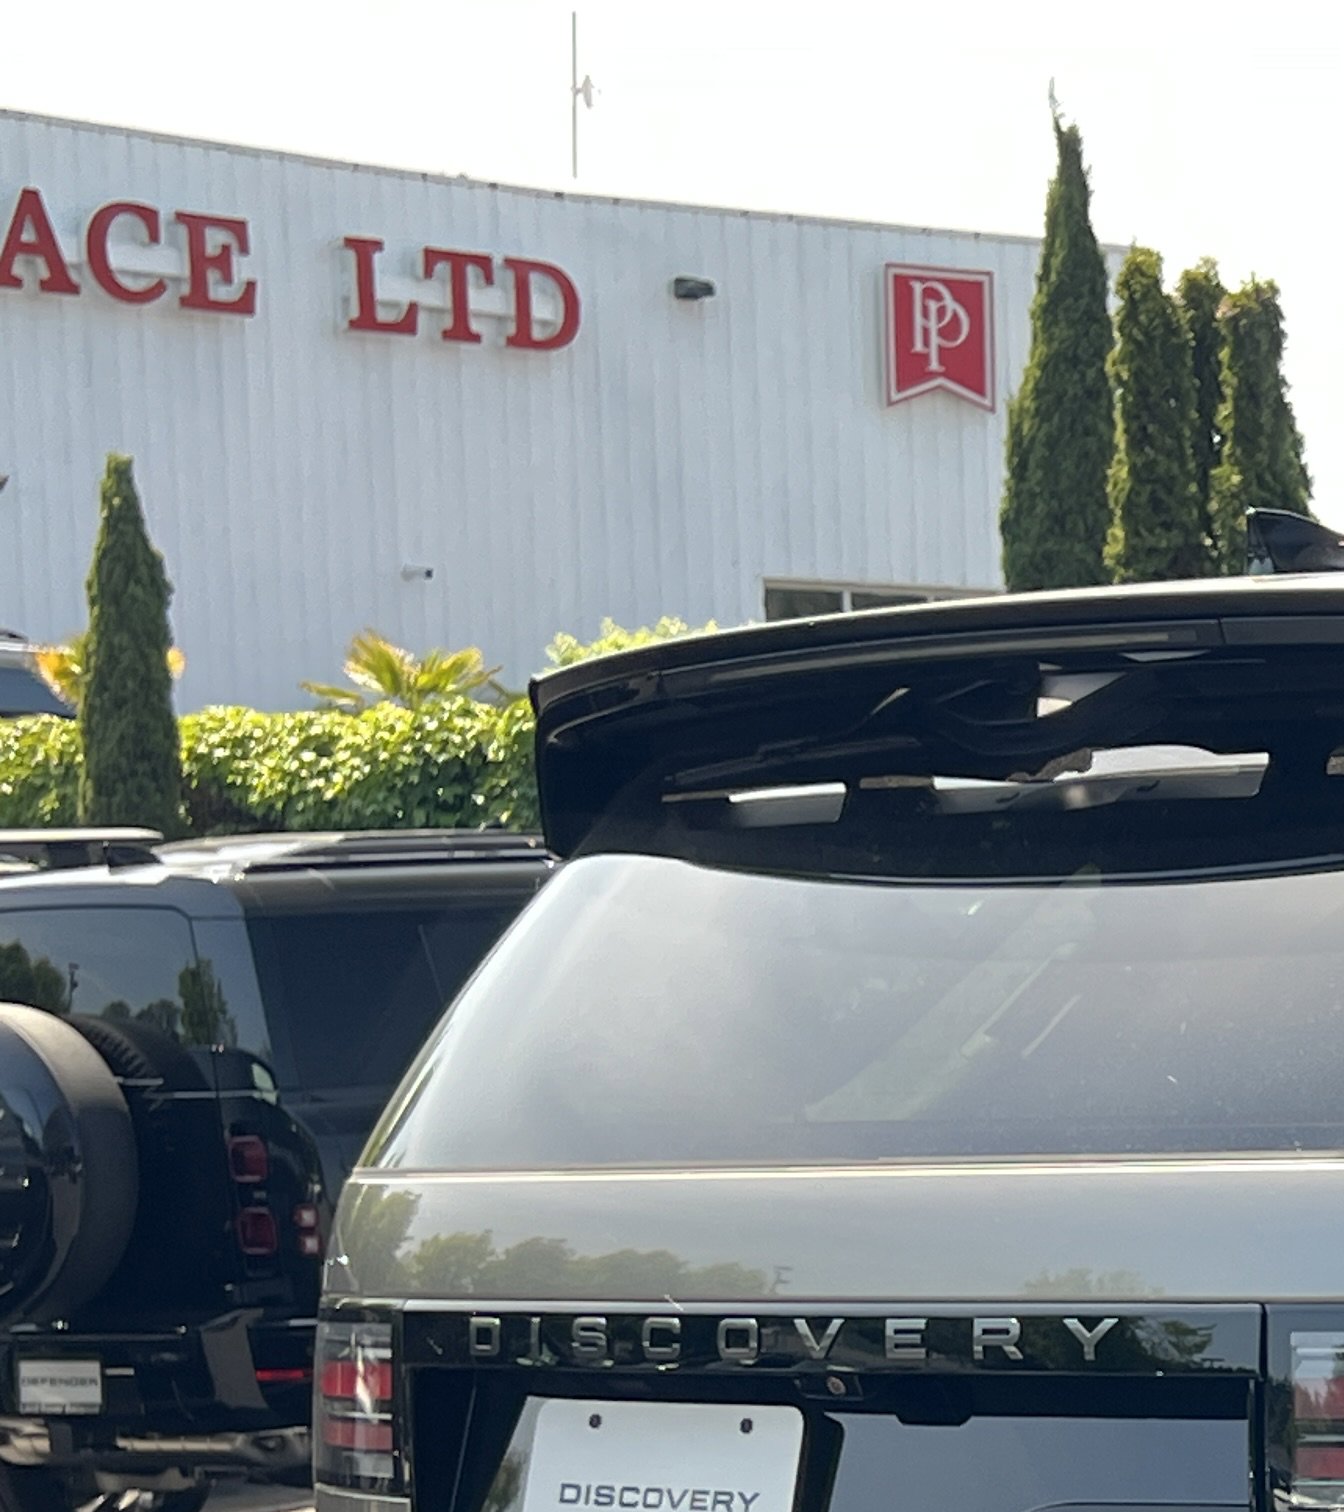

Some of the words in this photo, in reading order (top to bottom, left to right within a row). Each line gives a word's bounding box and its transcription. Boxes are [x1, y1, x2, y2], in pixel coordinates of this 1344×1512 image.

[0, 186, 257, 317] ACE
[343, 236, 581, 351] LTD
[468, 1315, 1120, 1362] DISCOVERY
